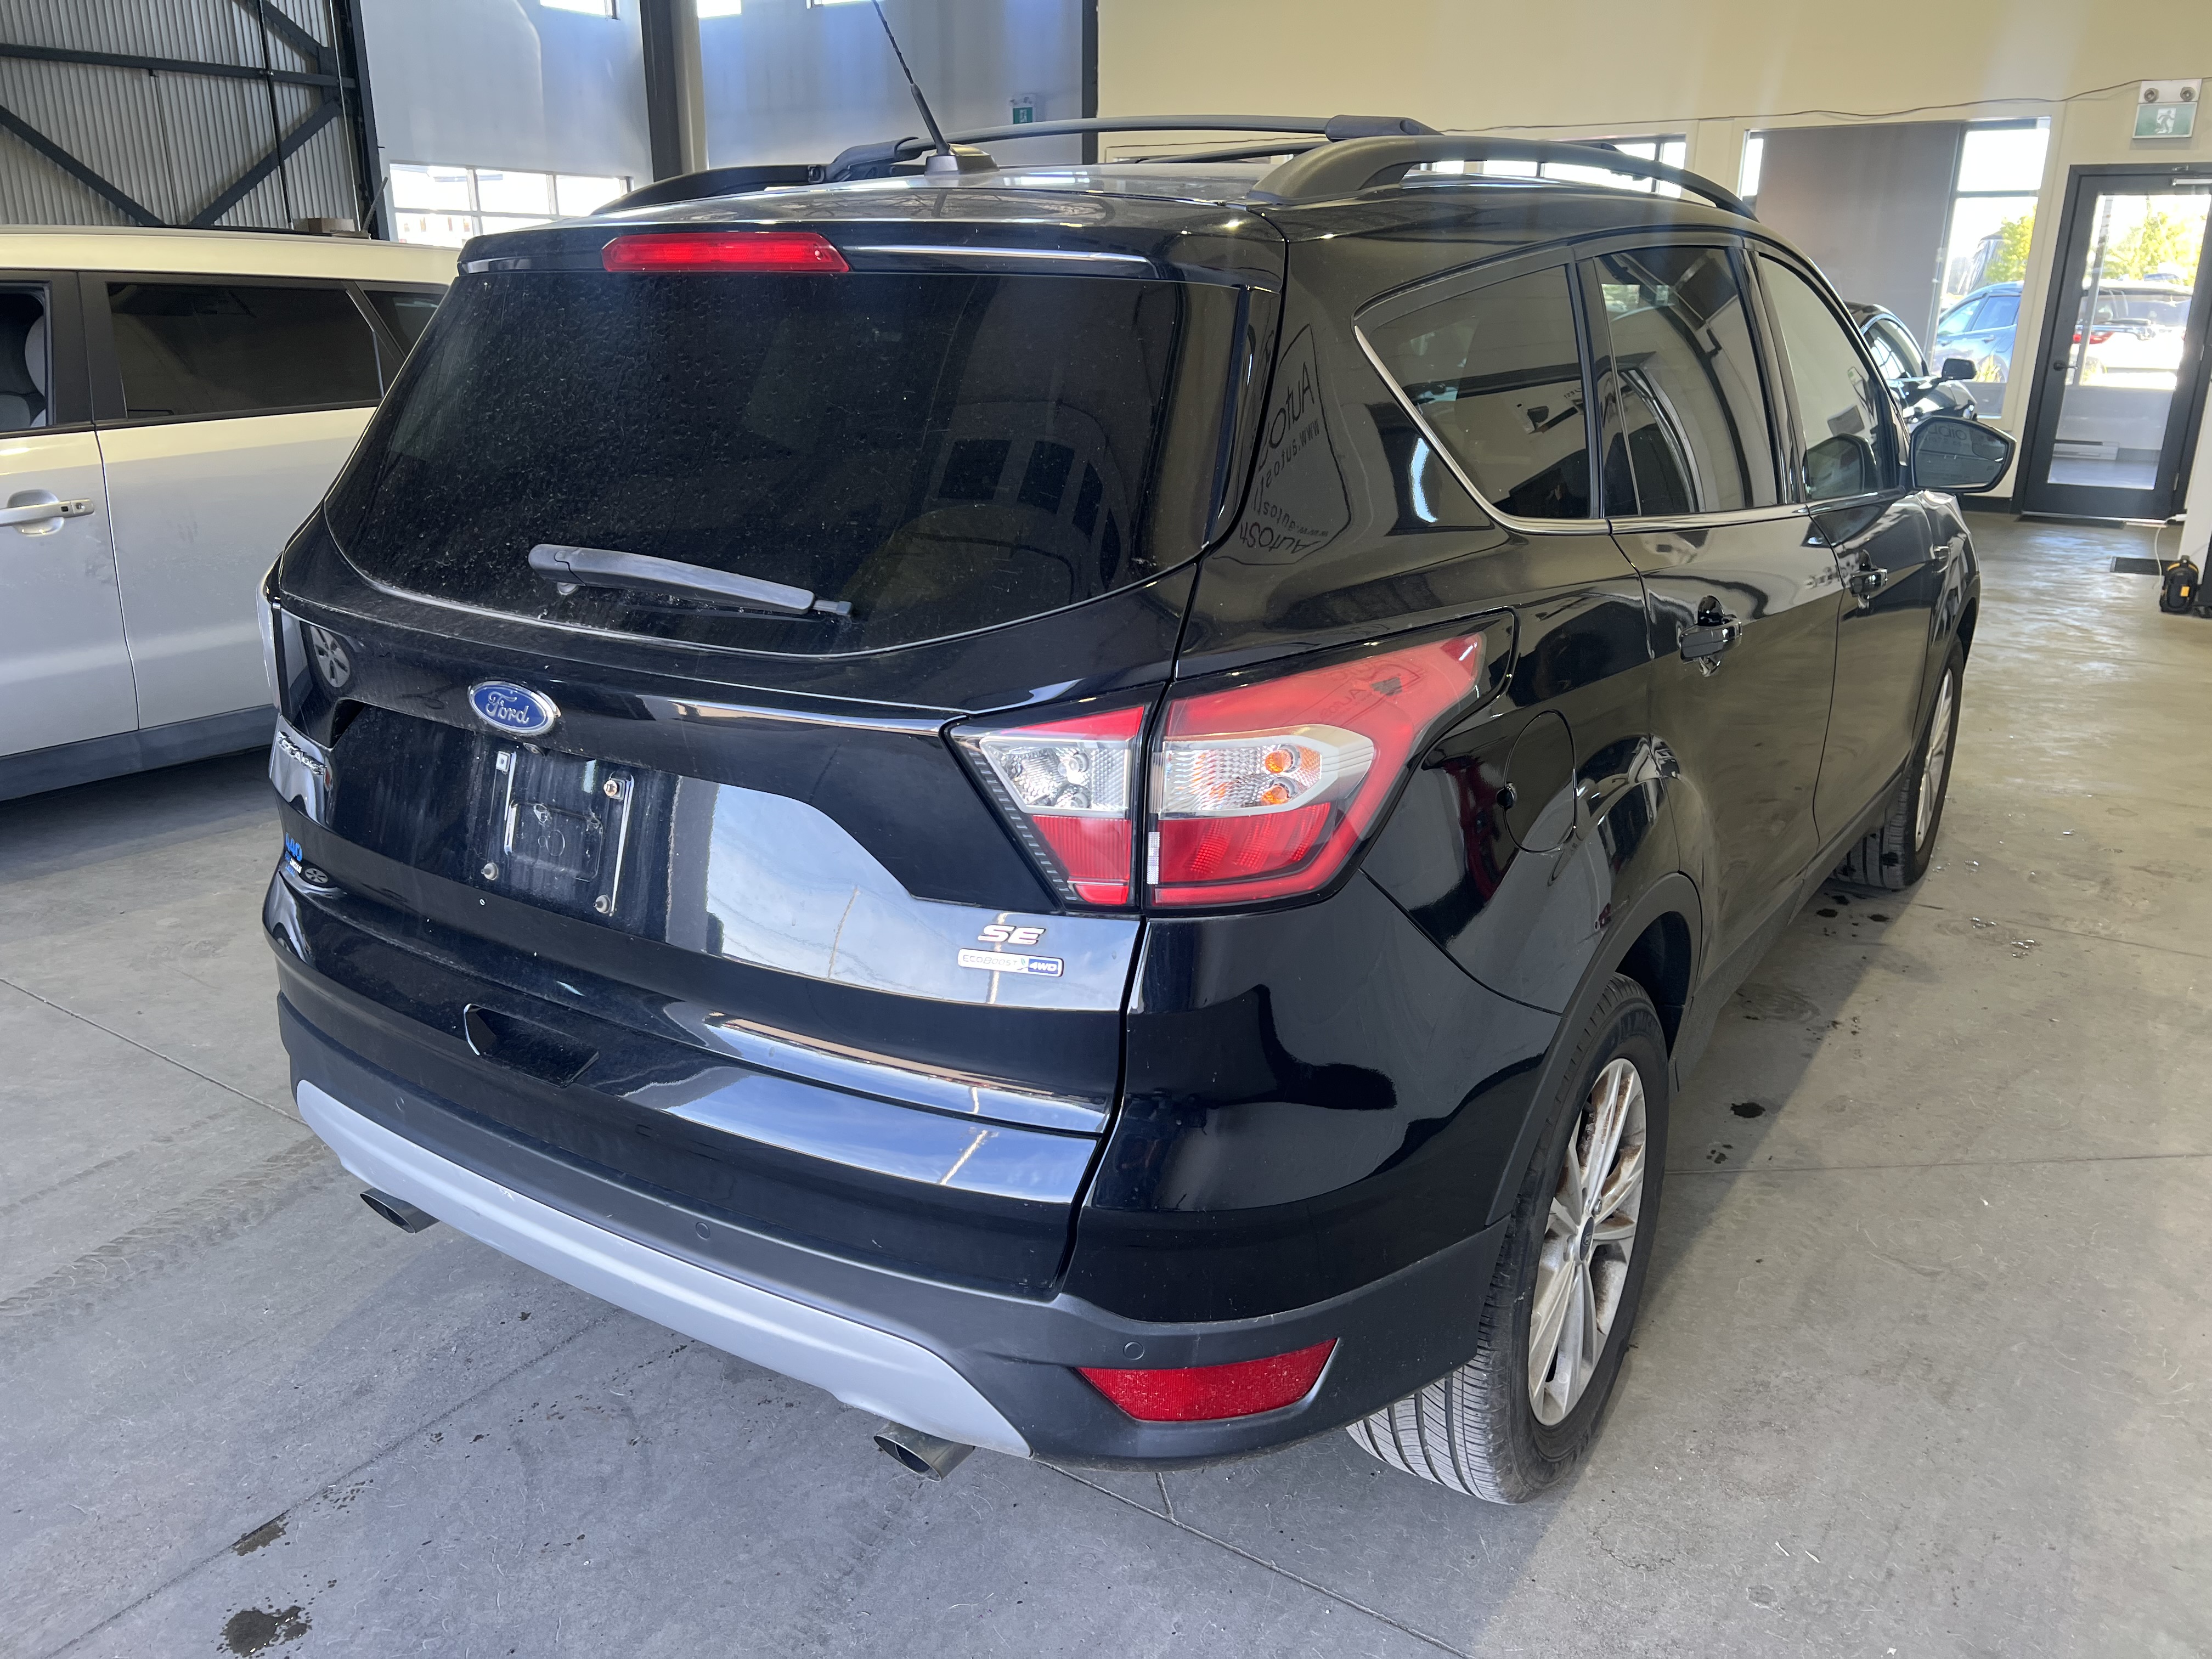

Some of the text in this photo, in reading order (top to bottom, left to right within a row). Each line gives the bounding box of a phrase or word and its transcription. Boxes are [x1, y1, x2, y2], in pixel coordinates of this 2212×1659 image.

[486, 690, 530, 725] Ford
[978, 924, 1047, 945] SE
[1029, 961, 1058, 972] 4WD
